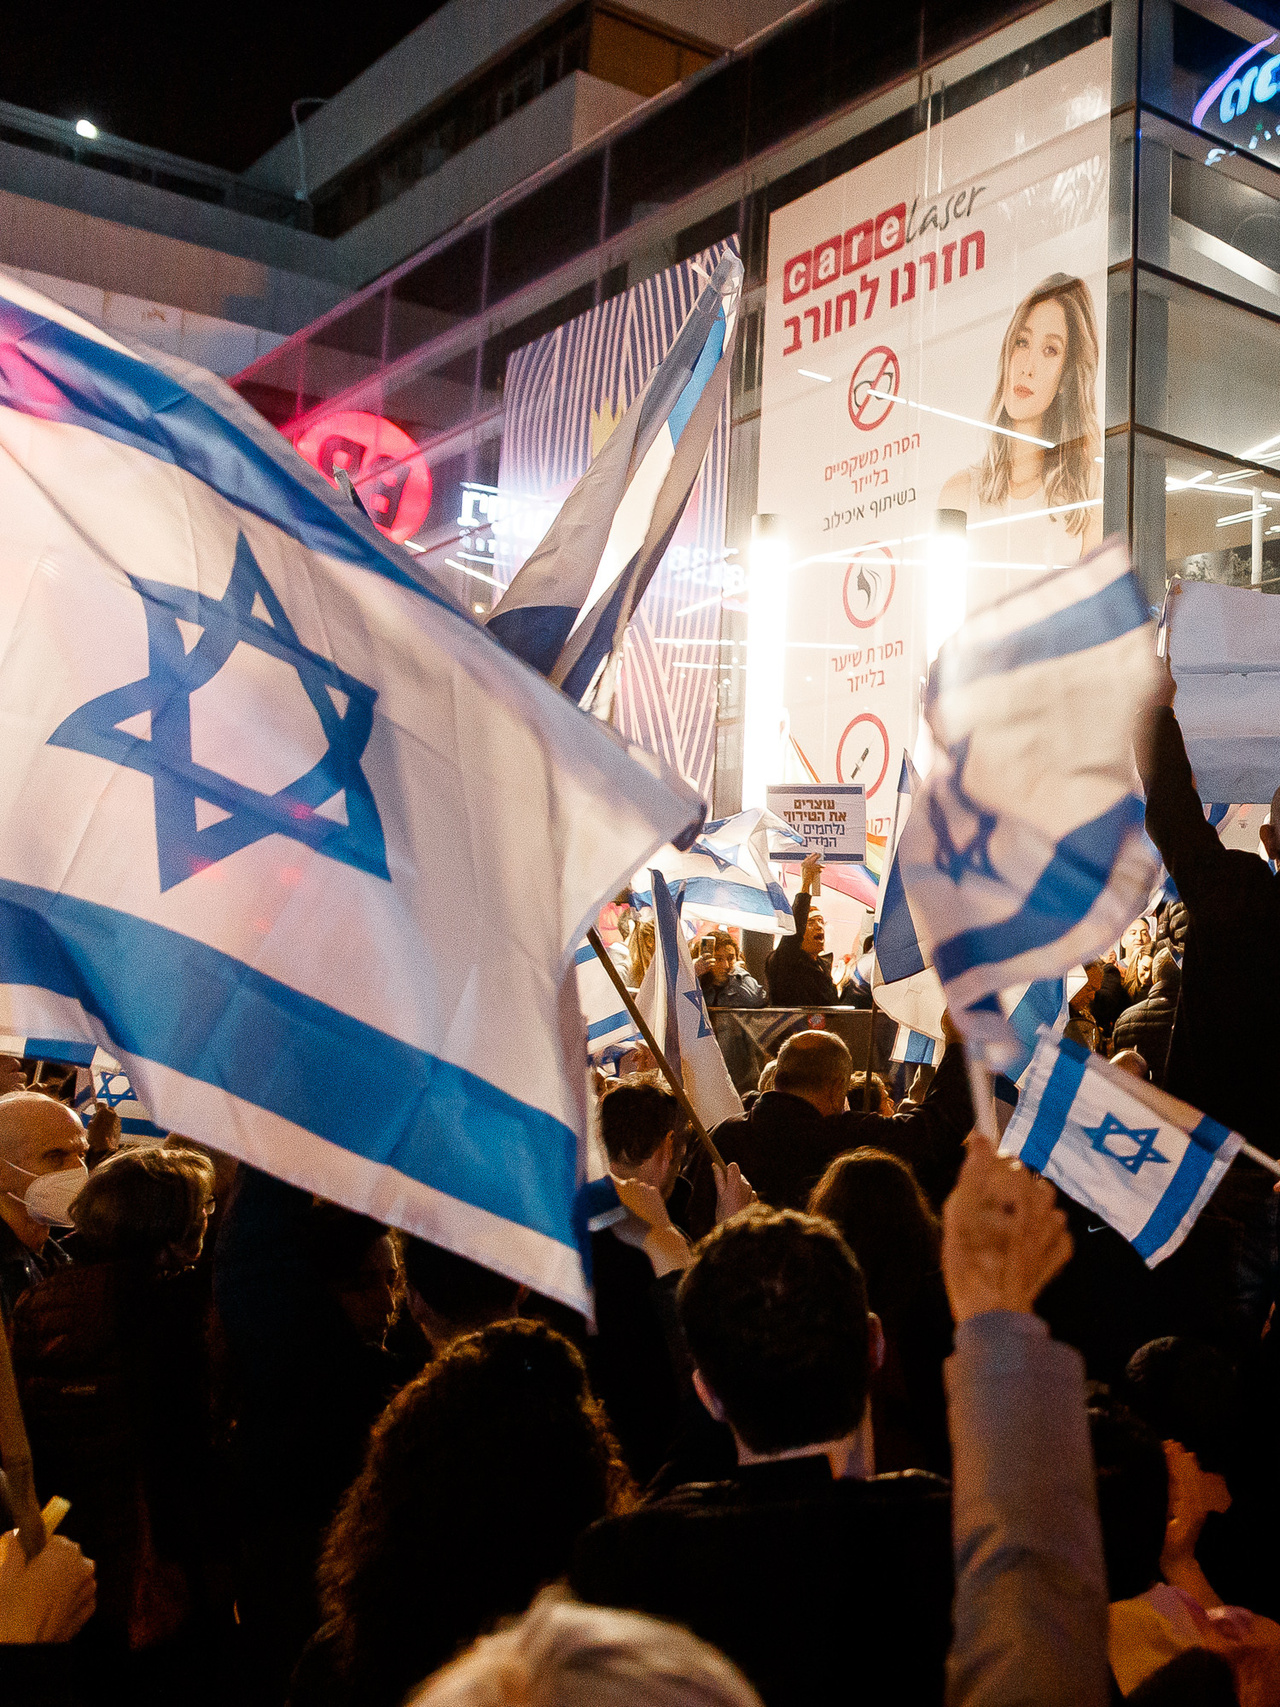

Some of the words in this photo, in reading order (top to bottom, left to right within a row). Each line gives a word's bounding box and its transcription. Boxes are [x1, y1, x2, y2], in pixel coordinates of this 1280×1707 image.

[890, 229, 986, 309] חזרנו
[782, 273, 880, 357] לחורב
[883, 432, 921, 461] הסרת
[823, 448, 880, 482] משקפיים
[850, 466, 890, 495] בלייזר
[869, 486, 917, 518] בשיתוף
[822, 503, 866, 533] איכילוב
[831, 650, 864, 673] שיער
[865, 639, 904, 665] הסרת
[846, 669, 886, 693] בלייזר
[783, 811, 826, 823] הטירוף
[793, 799, 836, 810] עוצרים
[828, 811, 847, 822] את
[803, 822, 846, 836] נלחמים
